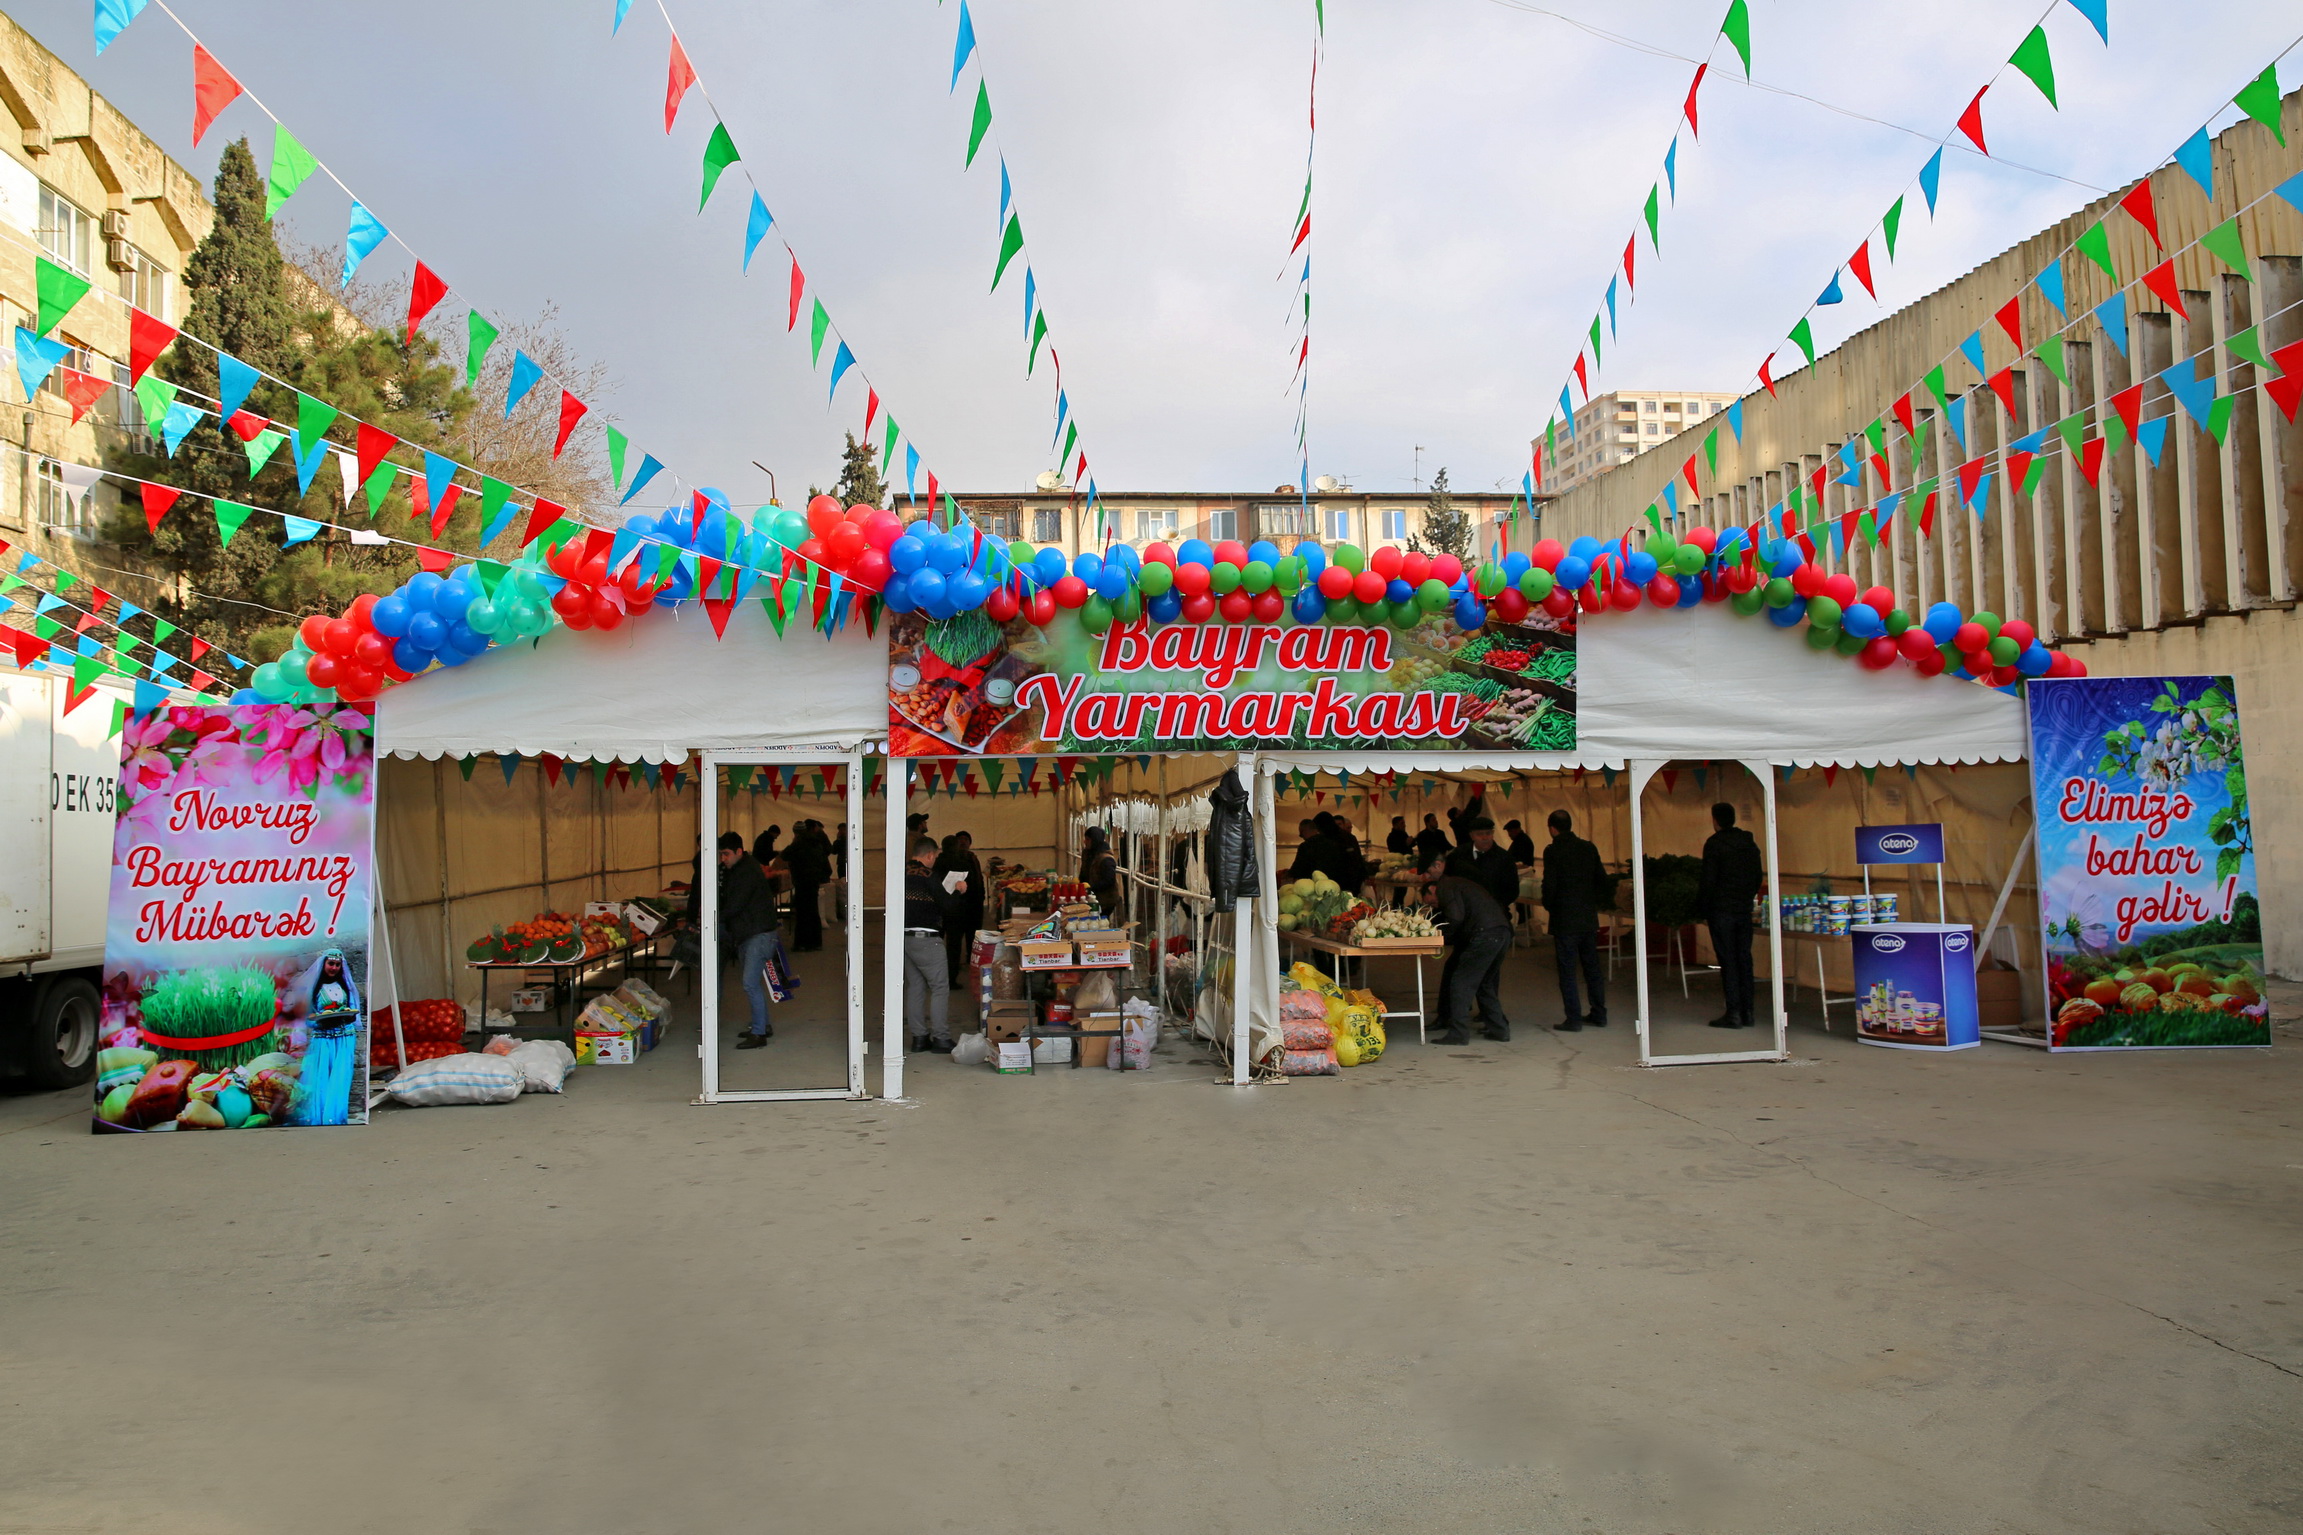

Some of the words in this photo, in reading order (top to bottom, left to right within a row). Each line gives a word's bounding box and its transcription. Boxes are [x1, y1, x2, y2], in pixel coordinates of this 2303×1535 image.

[1090, 608, 1394, 691] Bayram
[1014, 673, 1470, 740] Yarmarkası
[66, 774, 90, 812] EK
[96, 776, 116, 813] 35
[168, 789, 318, 845] Novruz
[2059, 778, 2194, 839] Elimizə
[1882, 838, 1914, 849] atena
[2086, 833, 2202, 876] bahar
[126, 845, 356, 903] Bayramınız
[135, 897, 316, 944] Mübarək
[2116, 880, 2210, 942] gəlir
[1874, 938, 1902, 948] atena
[1947, 937, 1966, 947] atena
